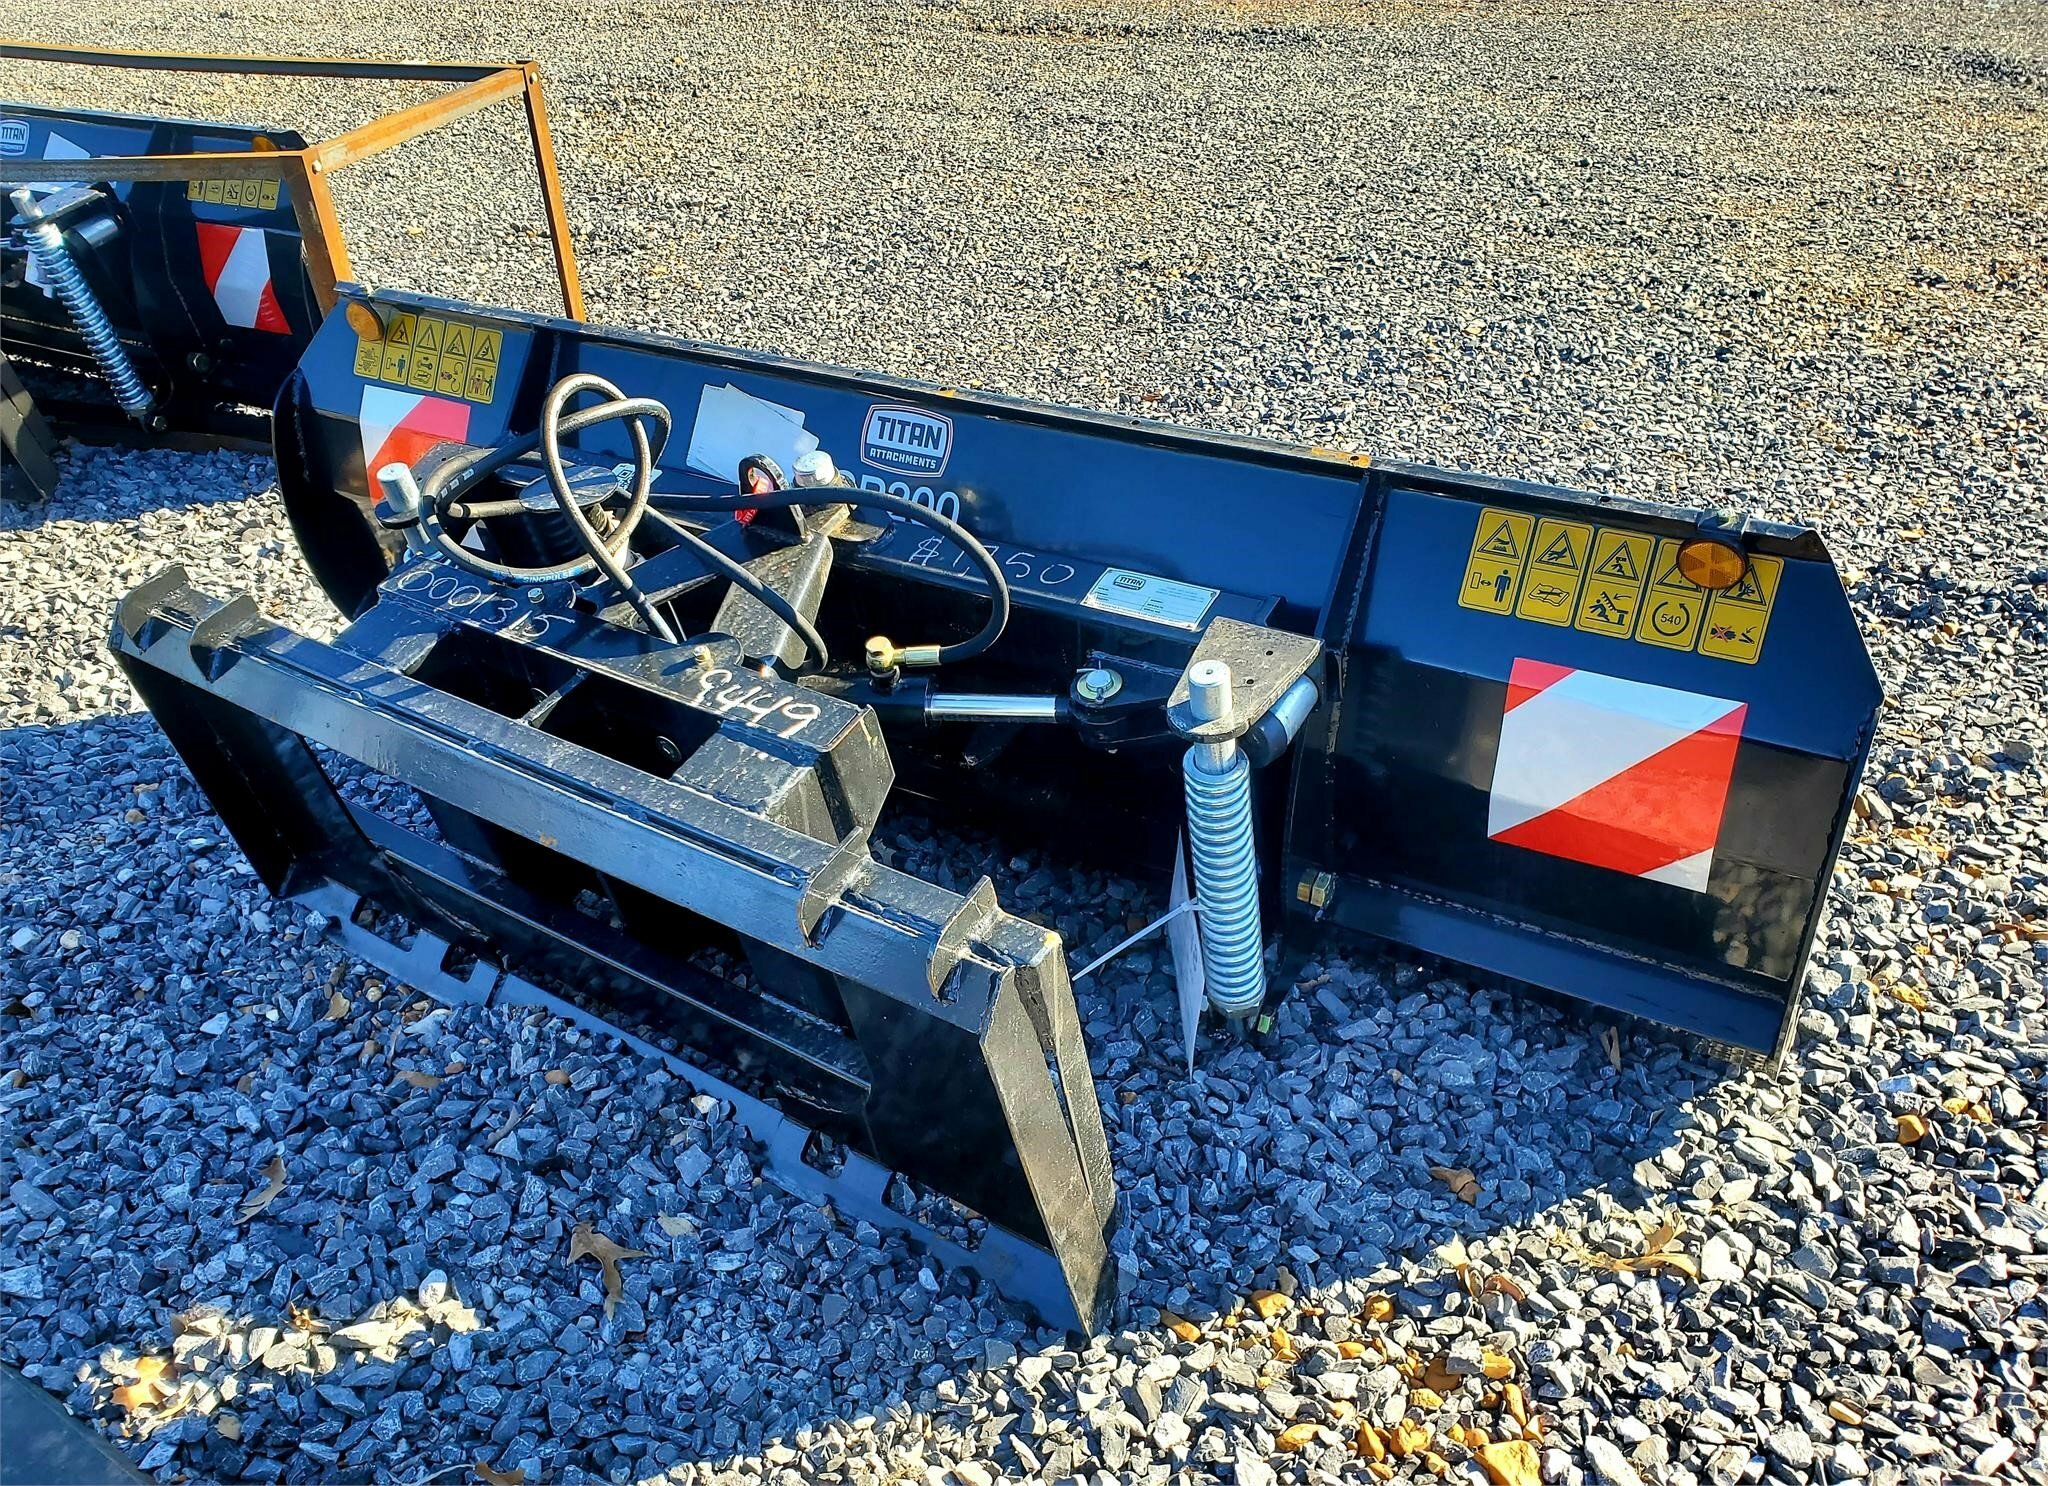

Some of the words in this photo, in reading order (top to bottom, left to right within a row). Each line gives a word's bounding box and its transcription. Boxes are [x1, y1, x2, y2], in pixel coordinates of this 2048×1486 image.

[1, 126, 26, 141] TITAN
[877, 415, 943, 451] TITAN
[869, 447, 938, 469] ATTACHMENTS
[838, 469, 960, 529] 200
[523, 569, 576, 583] SINOPULSE
[1119, 576, 1145, 588] TITAN
[1660, 613, 1682, 626] 540
